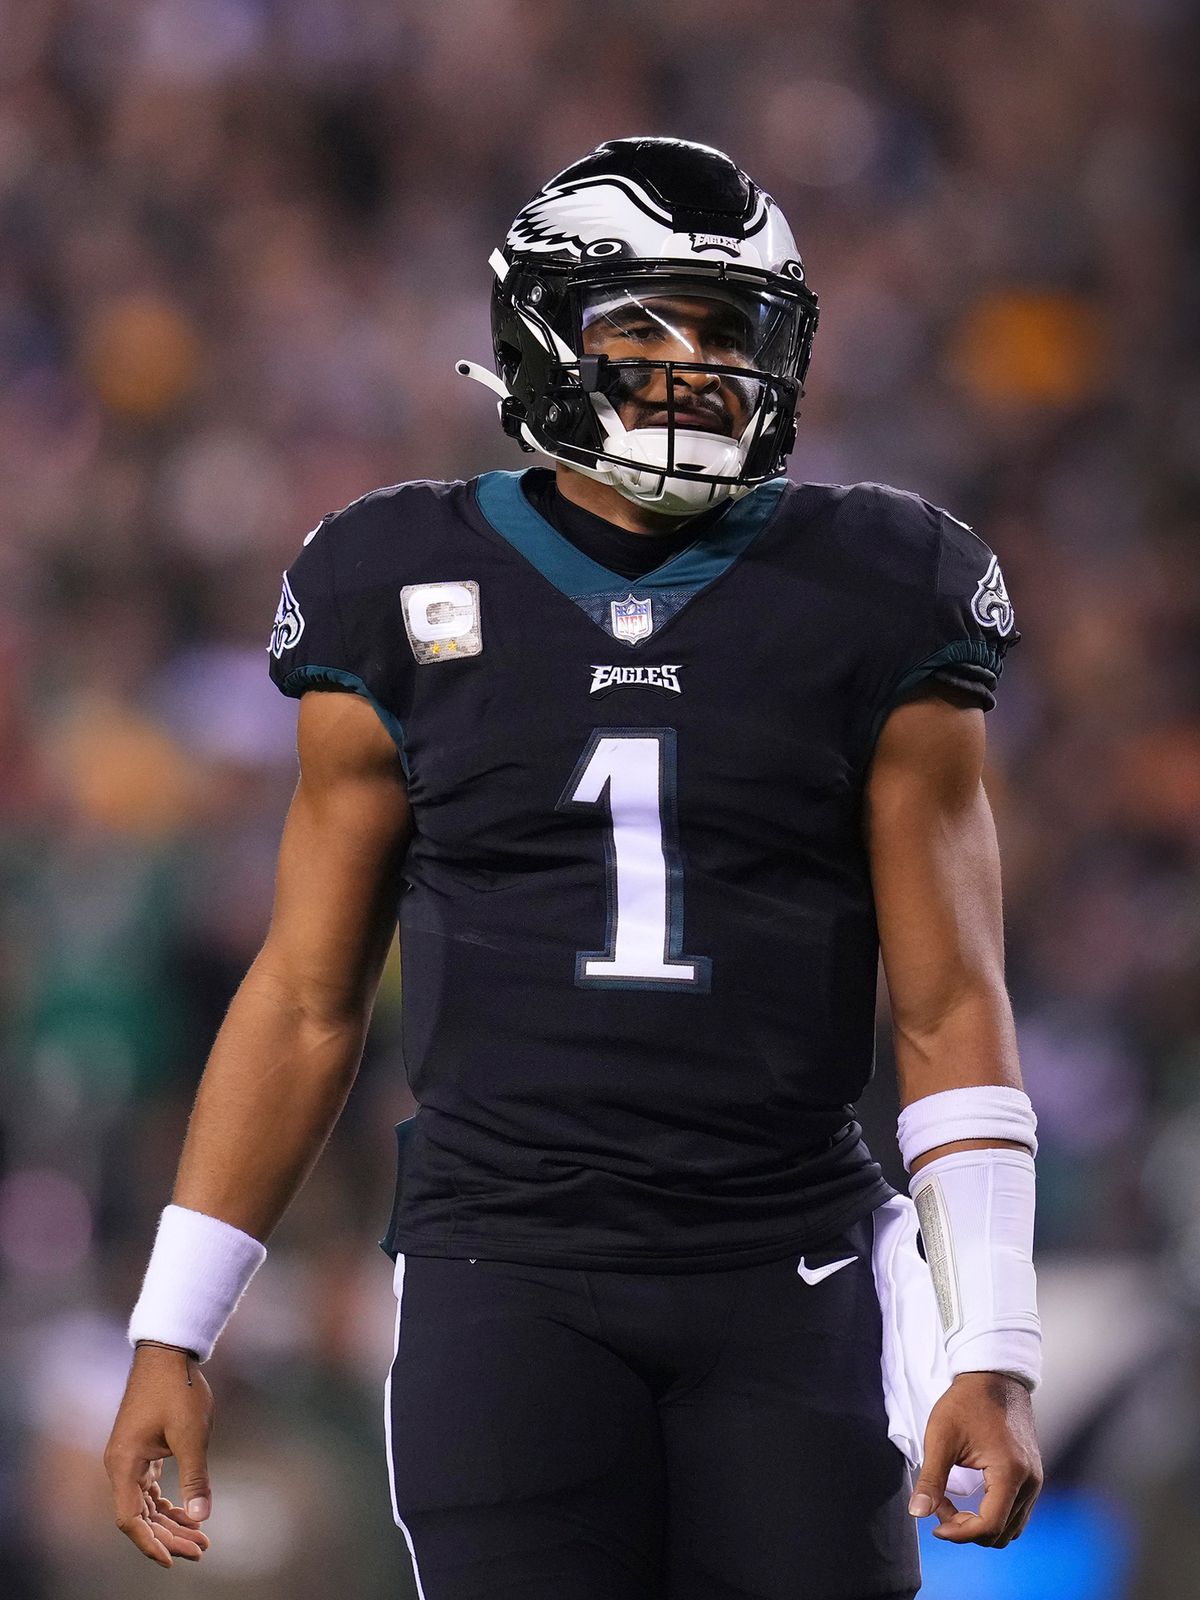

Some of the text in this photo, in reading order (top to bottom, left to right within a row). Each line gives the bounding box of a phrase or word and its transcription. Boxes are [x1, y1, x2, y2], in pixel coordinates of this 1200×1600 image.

[690, 233, 742, 254] EAGLES
[408, 585, 475, 642] C
[618, 615, 647, 636] NFL
[589, 664, 683, 695] EAGLES
[558, 730, 708, 990] 1
